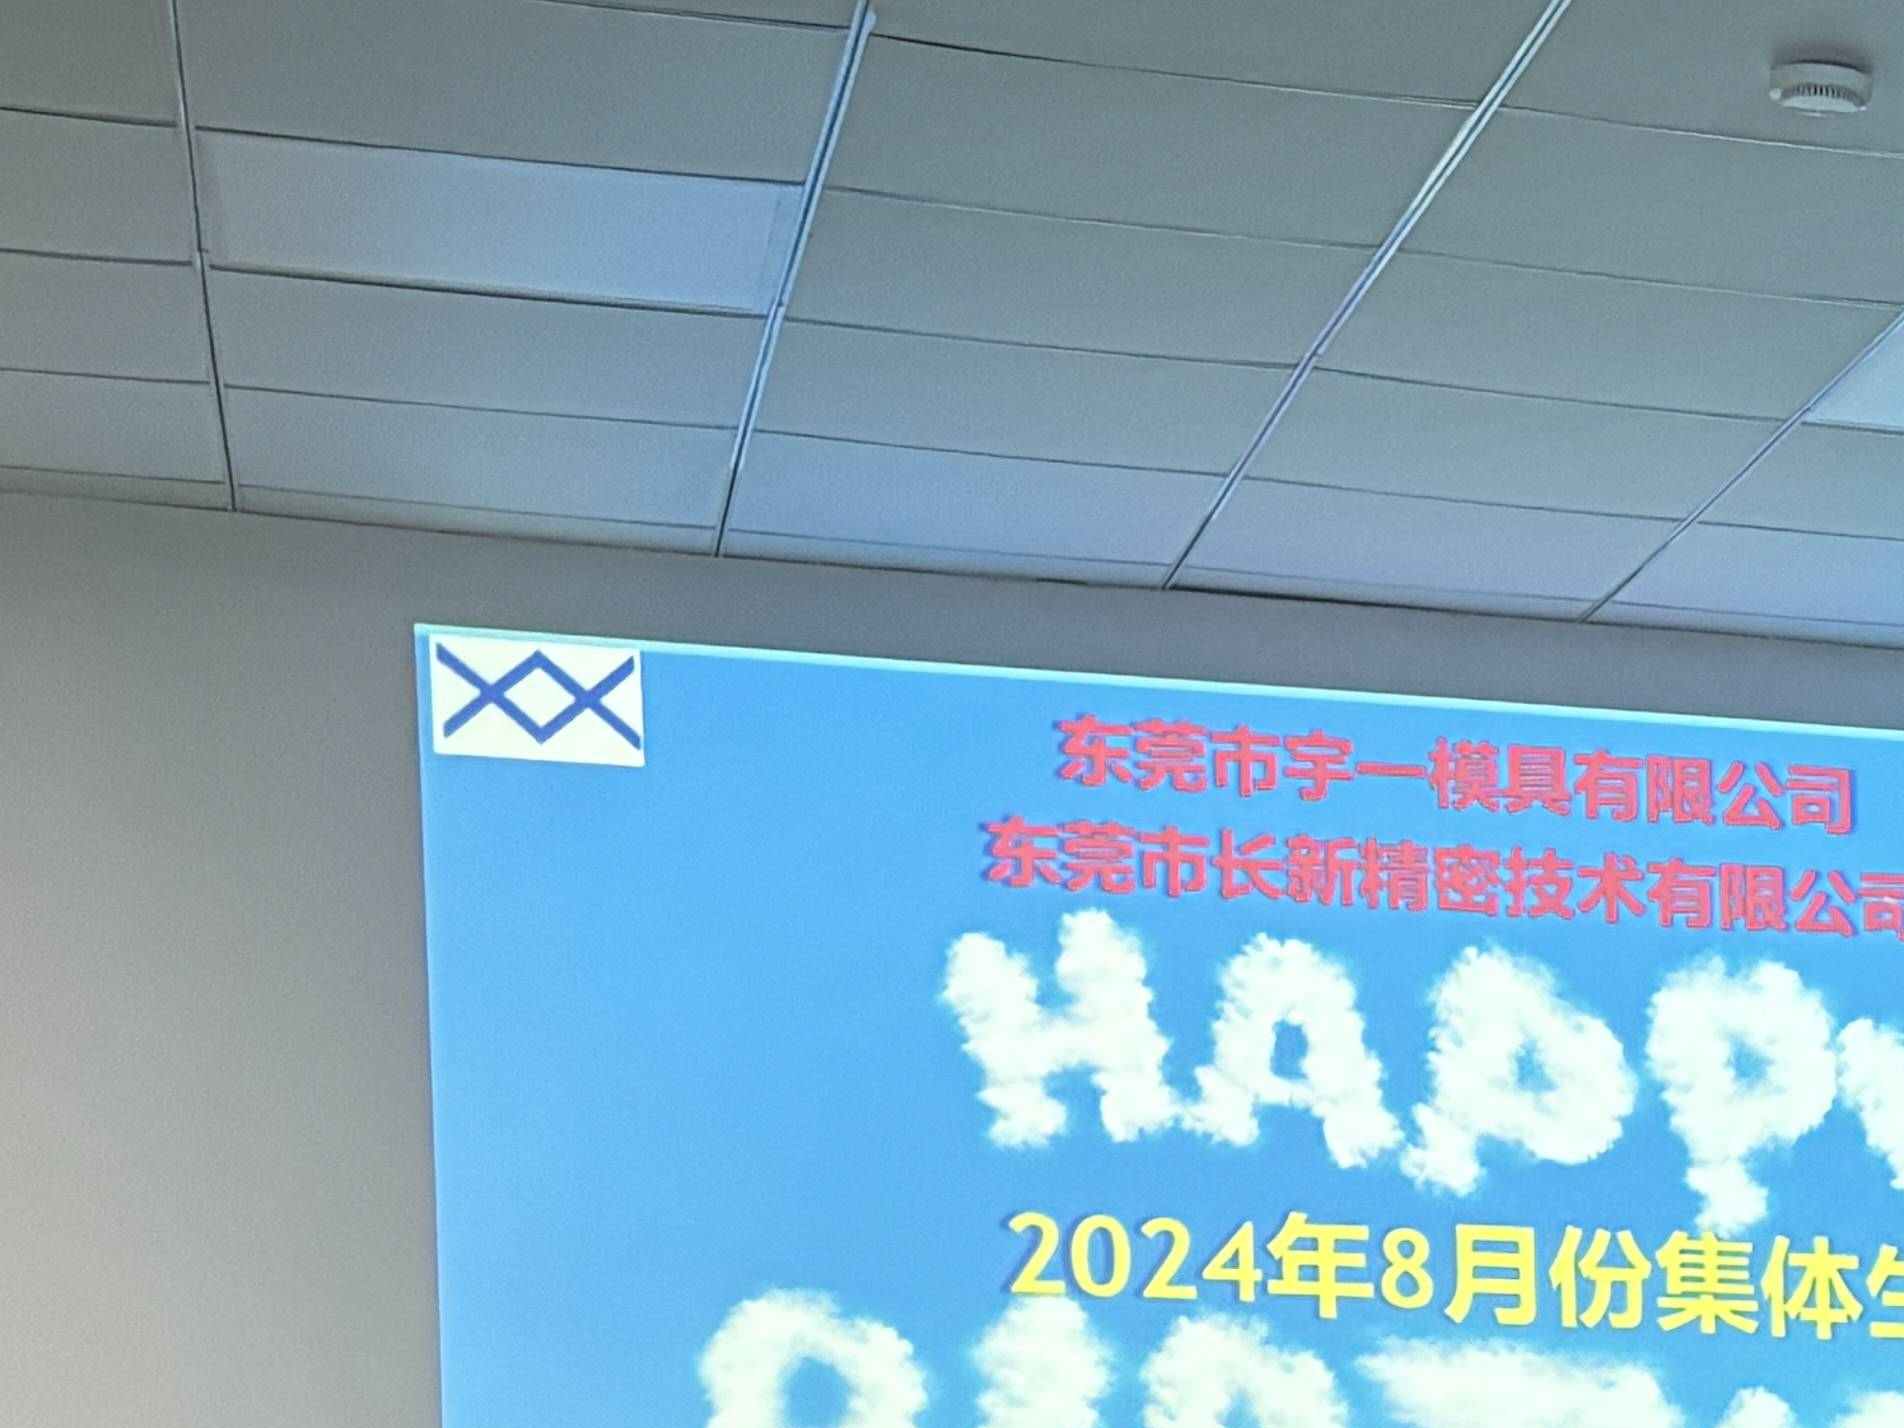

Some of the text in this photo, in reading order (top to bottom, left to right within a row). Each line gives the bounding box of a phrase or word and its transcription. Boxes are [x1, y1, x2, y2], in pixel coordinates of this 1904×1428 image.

[1056, 712, 1856, 838] 东莞市宇一模具有限公司
